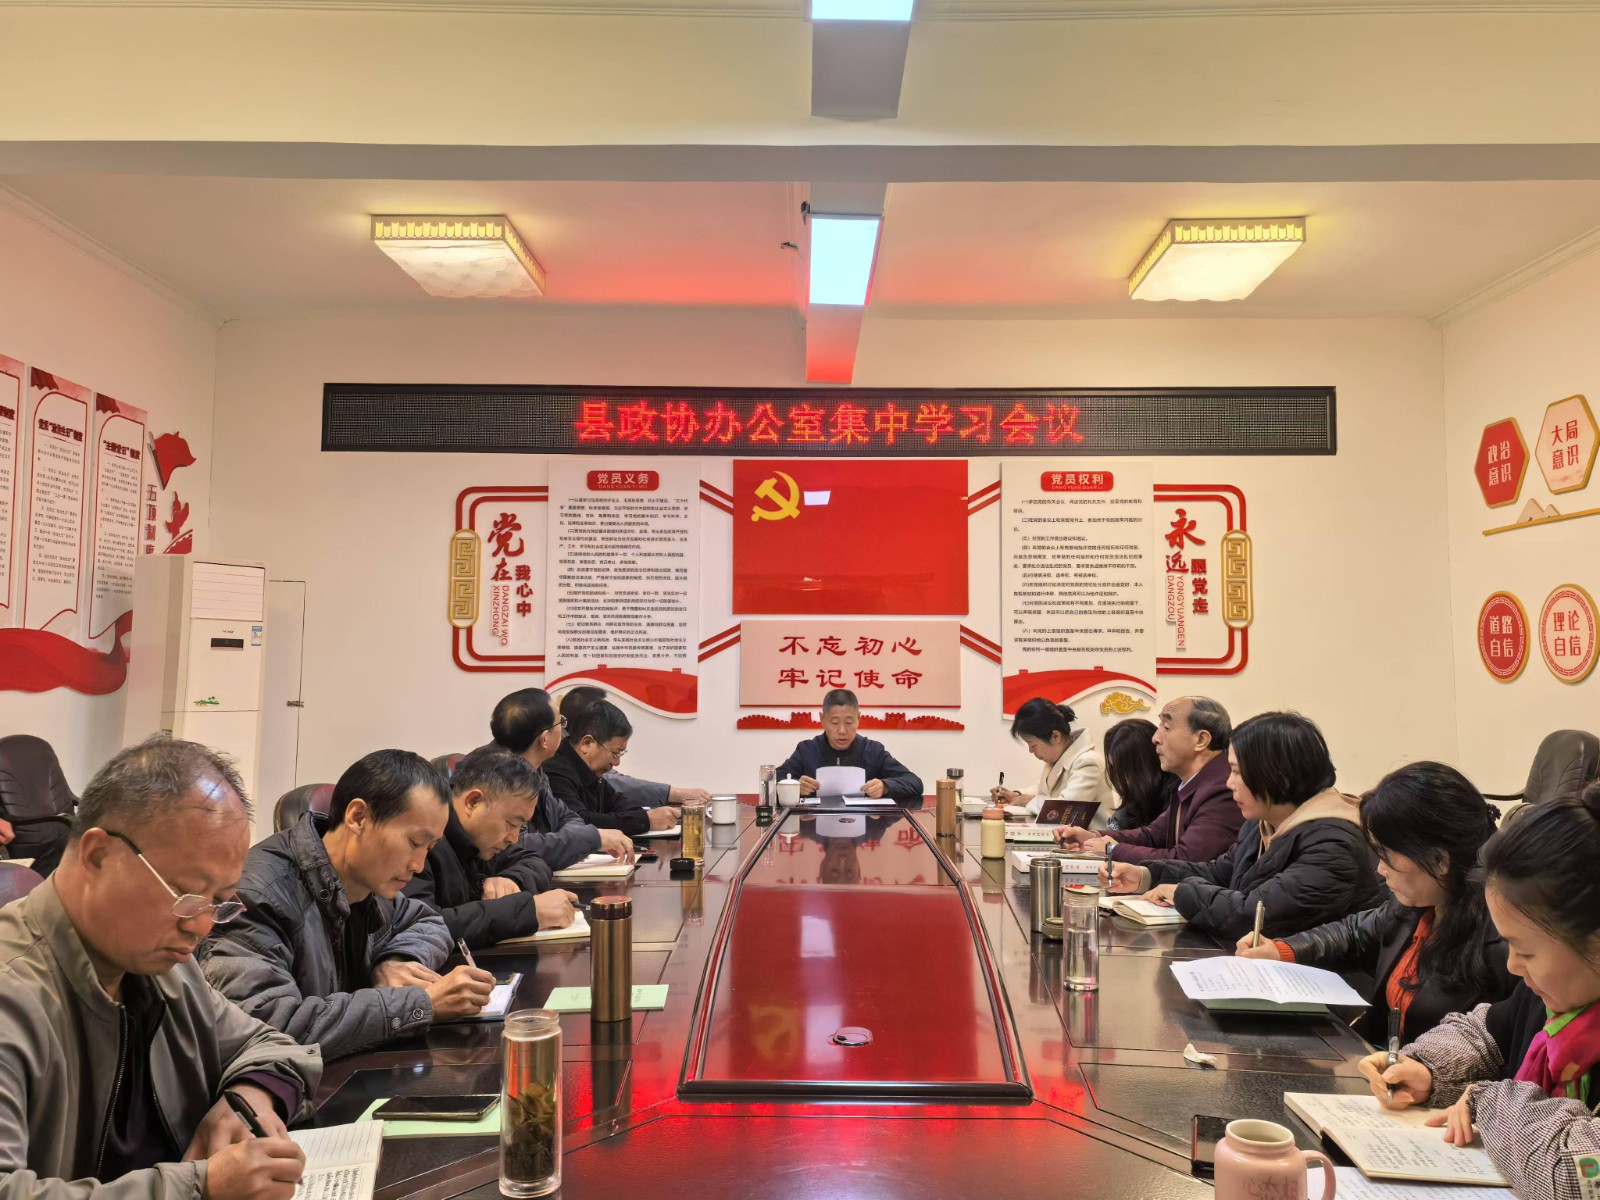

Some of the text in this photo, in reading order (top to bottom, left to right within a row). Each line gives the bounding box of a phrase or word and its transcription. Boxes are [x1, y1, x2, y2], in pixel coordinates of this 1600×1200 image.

[574, 401, 1084, 445] 县政协办公室集中学习会议
[1551, 419, 1579, 447] 大局
[1487, 440, 1511, 464] 政治
[1552, 444, 1579, 471] 意识
[597, 472, 649, 485] 党员义务
[1051, 473, 1104, 485] 党员权利
[1488, 462, 1512, 487] 意识
[1165, 508, 1206, 575] 永远
[515, 564, 534, 617] 我心中
[1167, 575, 1175, 621] DANGZOU
[492, 585, 500, 637] XINZHONG
[1177, 575, 1185, 647] YONGYUANGEN
[1553, 610, 1580, 632] 理论
[1489, 615, 1513, 635] 道路
[778, 635, 923, 656] 不忘初心
[1490, 638, 1514, 658] 自信
[1554, 635, 1581, 657] 自信
[777, 668, 923, 689] 牢记使命
